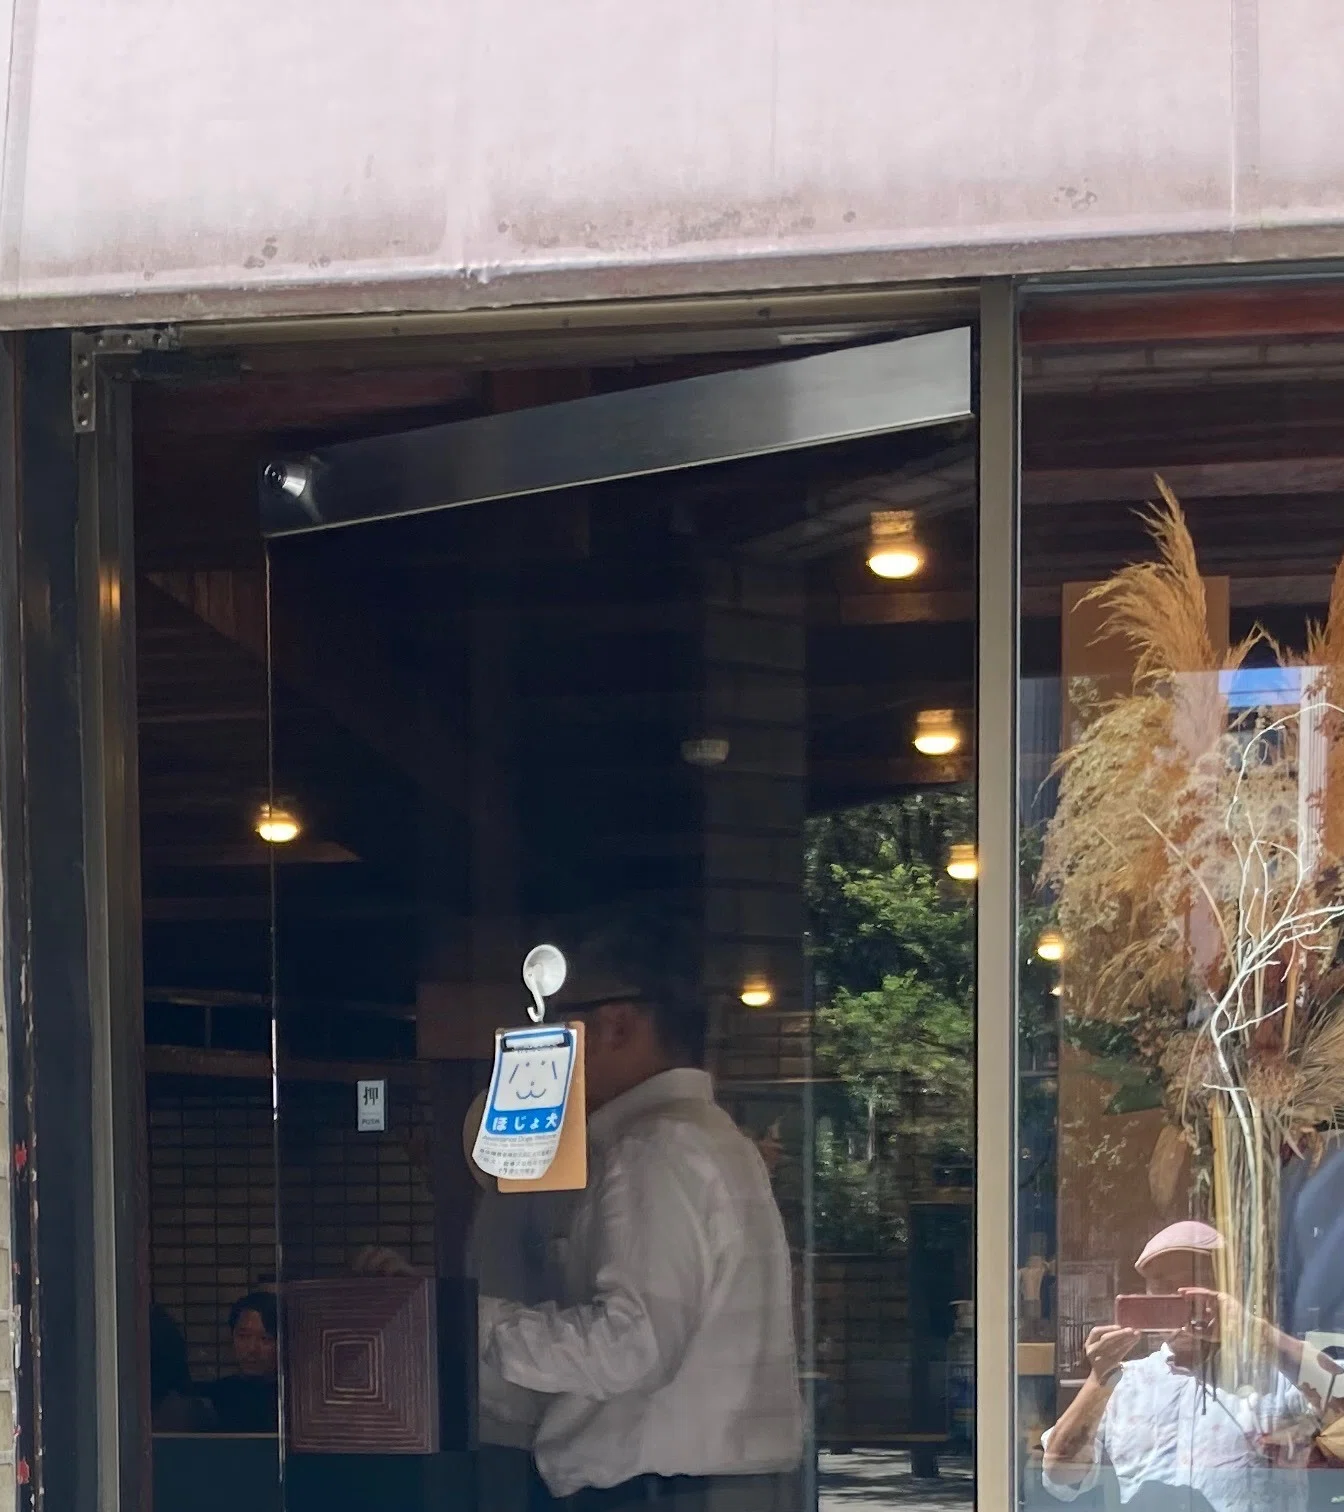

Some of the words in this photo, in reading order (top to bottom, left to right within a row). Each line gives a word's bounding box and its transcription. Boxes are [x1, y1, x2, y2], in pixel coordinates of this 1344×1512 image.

[363, 1086, 379, 1106] 押
[492, 1112, 559, 1131] ほじょ犬
